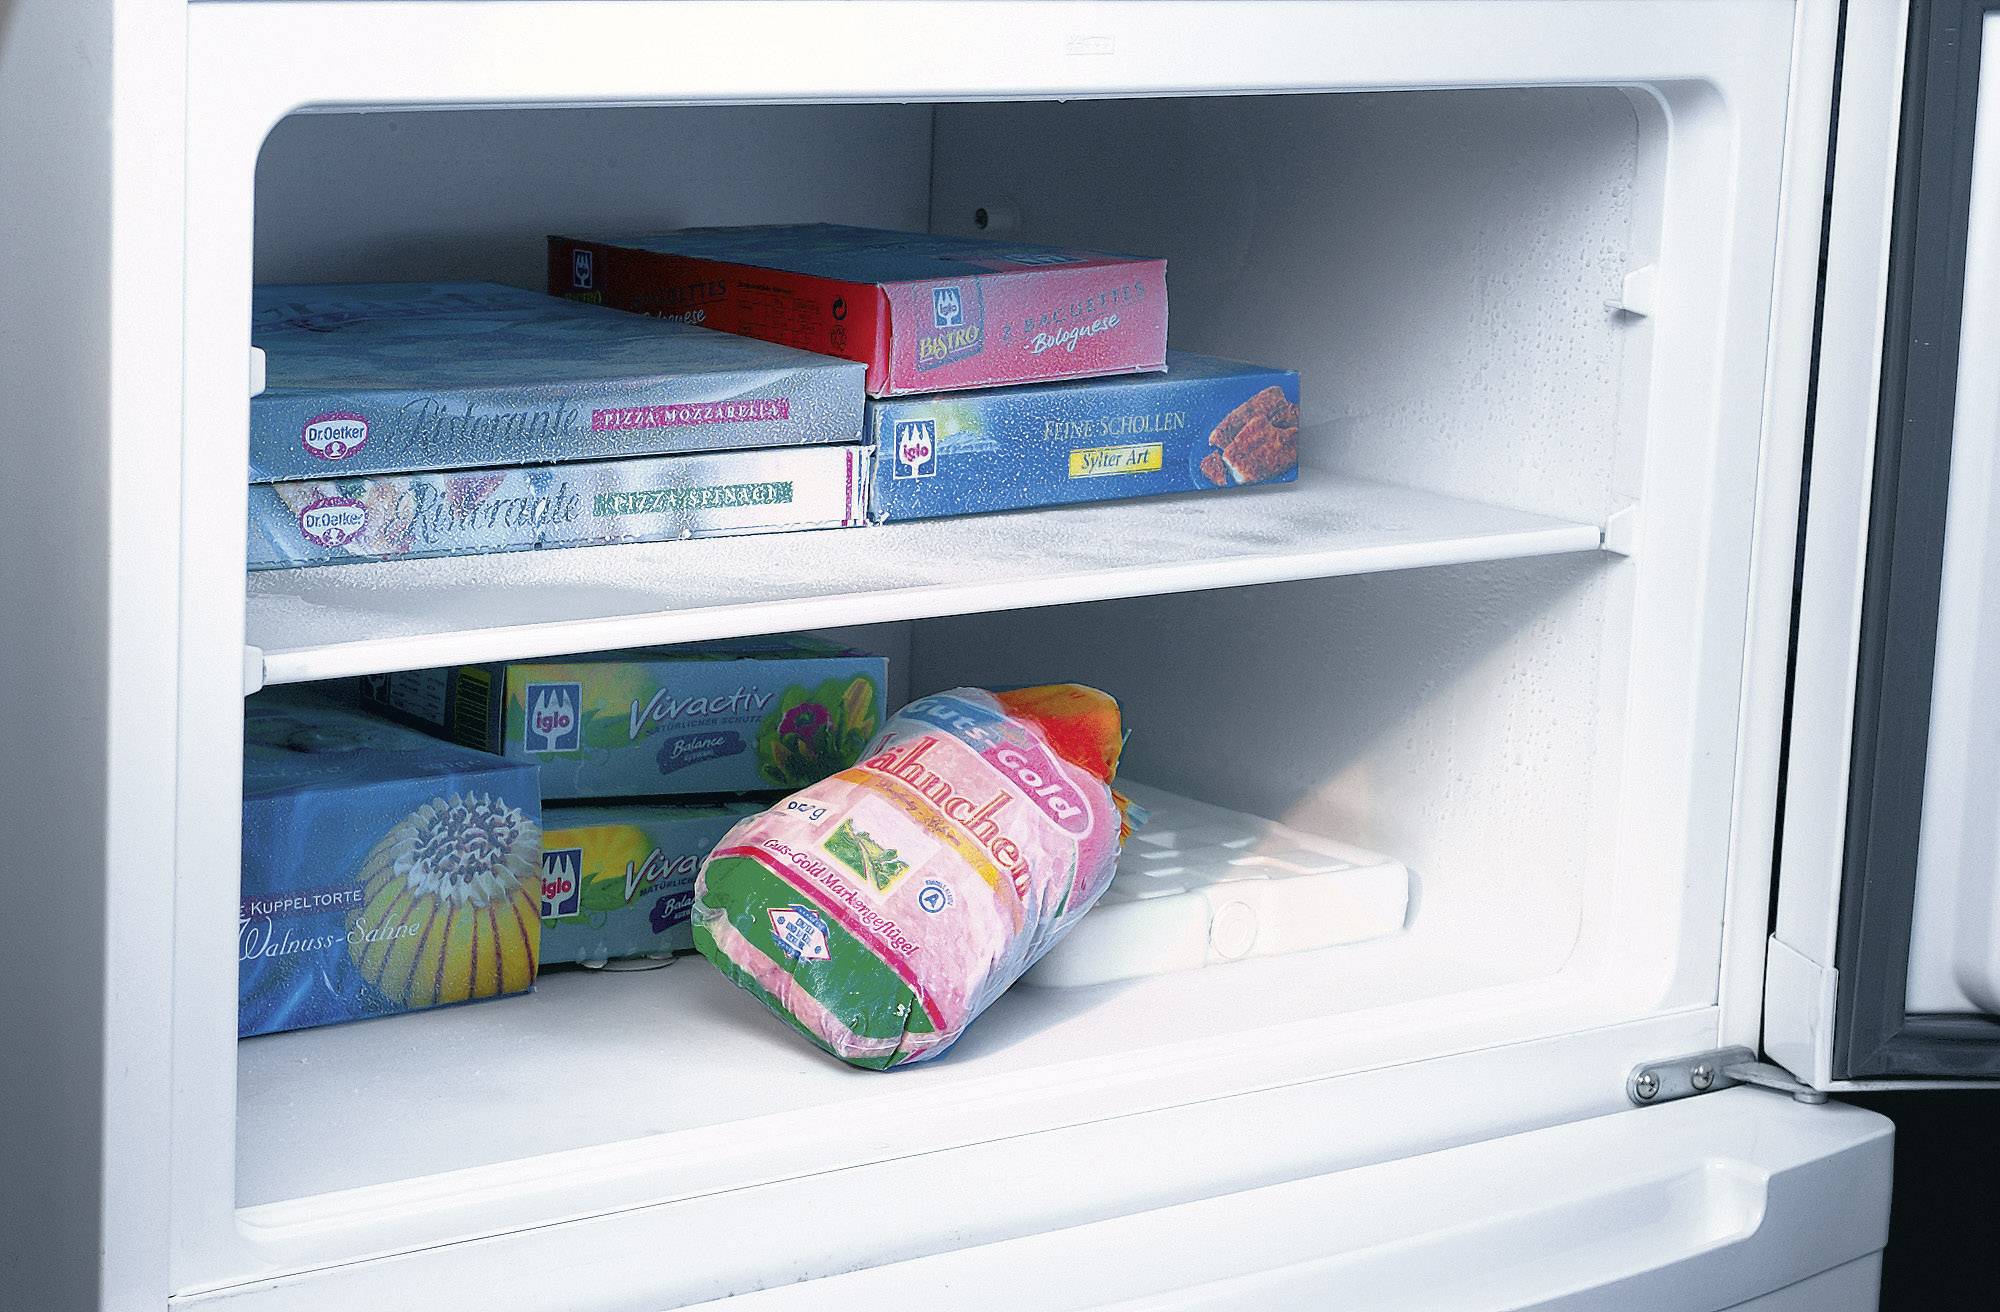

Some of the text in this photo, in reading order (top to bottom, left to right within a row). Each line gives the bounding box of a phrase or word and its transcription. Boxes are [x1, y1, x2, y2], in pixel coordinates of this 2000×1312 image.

[1023, 281, 1146, 333] BAGUETTES
[919, 325, 980, 359] BISTRO
[1026, 313, 1121, 355] Bolognese
[604, 411, 656, 427] PIZZA
[1043, 411, 1187, 441] FEINE SCHOLLEN
[903, 443, 930, 463] iglo
[1081, 449, 1150, 474] Sylter Art
[613, 491, 676, 512] PIZZA
[536, 711, 571, 733] iglo
[629, 685, 774, 740] Vivactiv
[670, 736, 726, 760] Balance
[997, 749, 1083, 820] Gold
[251, 889, 363, 915] KUPPELTORTE
[541, 877, 572, 900] iglo
[763, 838, 828, 881] Guts-Gold
[820, 872, 921, 958] Markengeflügel
[240, 912, 421, 961] Walnuss-Sahne
